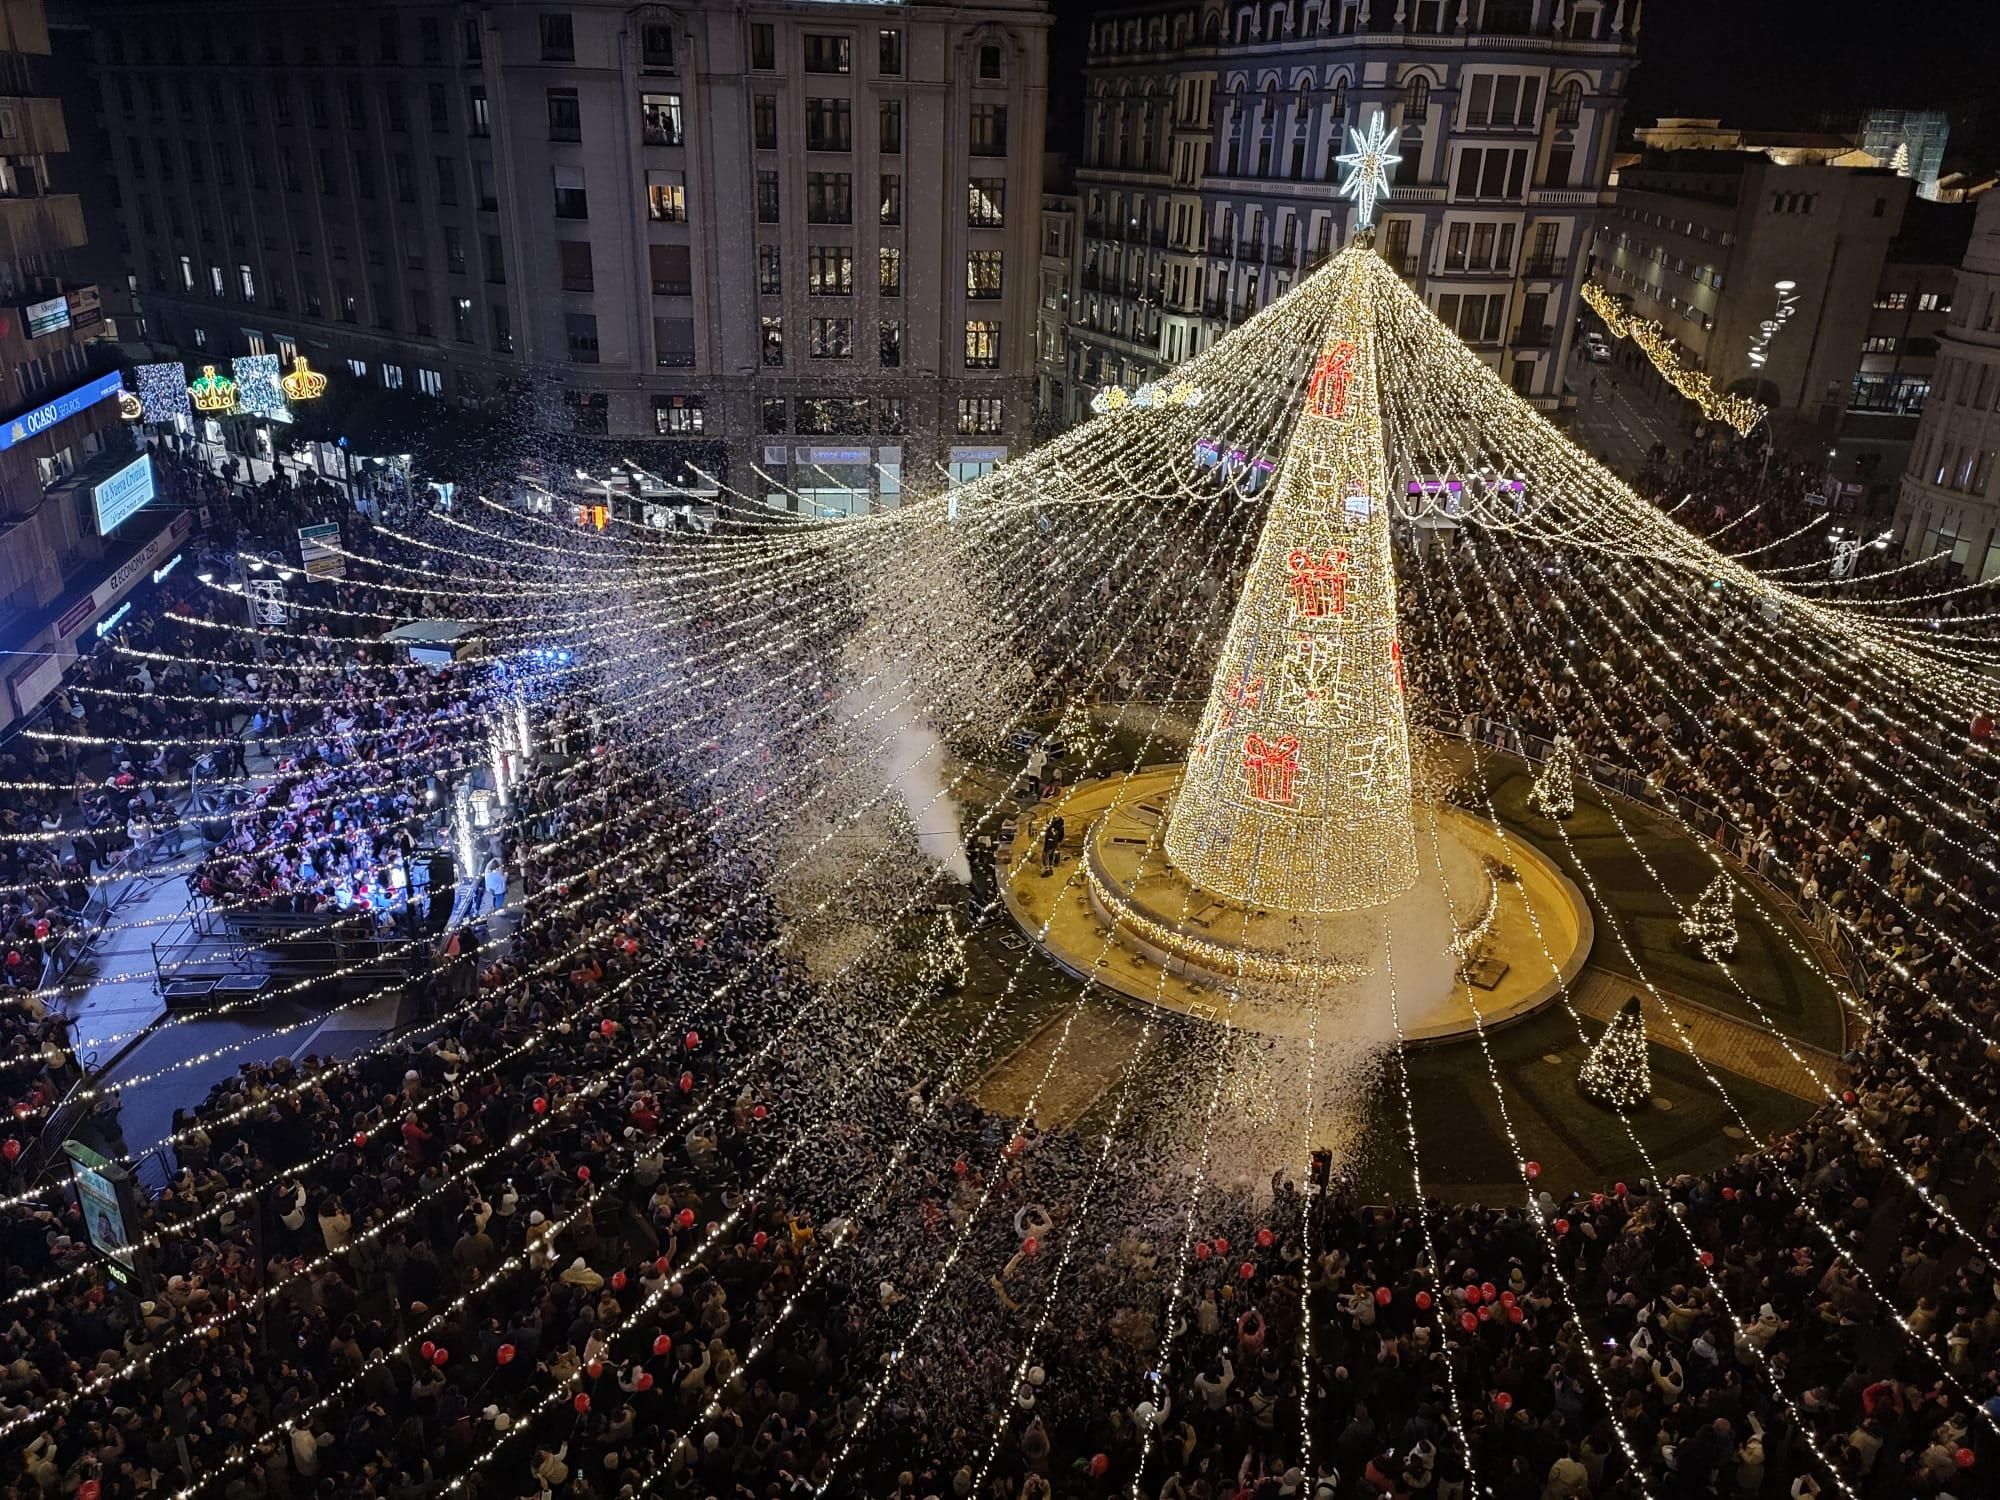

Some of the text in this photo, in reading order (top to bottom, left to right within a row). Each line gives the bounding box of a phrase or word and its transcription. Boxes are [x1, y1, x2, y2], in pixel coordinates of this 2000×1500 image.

[28, 397, 81, 432] OCASO SEGUROS
[101, 488, 110, 506] La
[108, 481, 127, 501] Nueva
[110, 575, 118, 590] EZ
